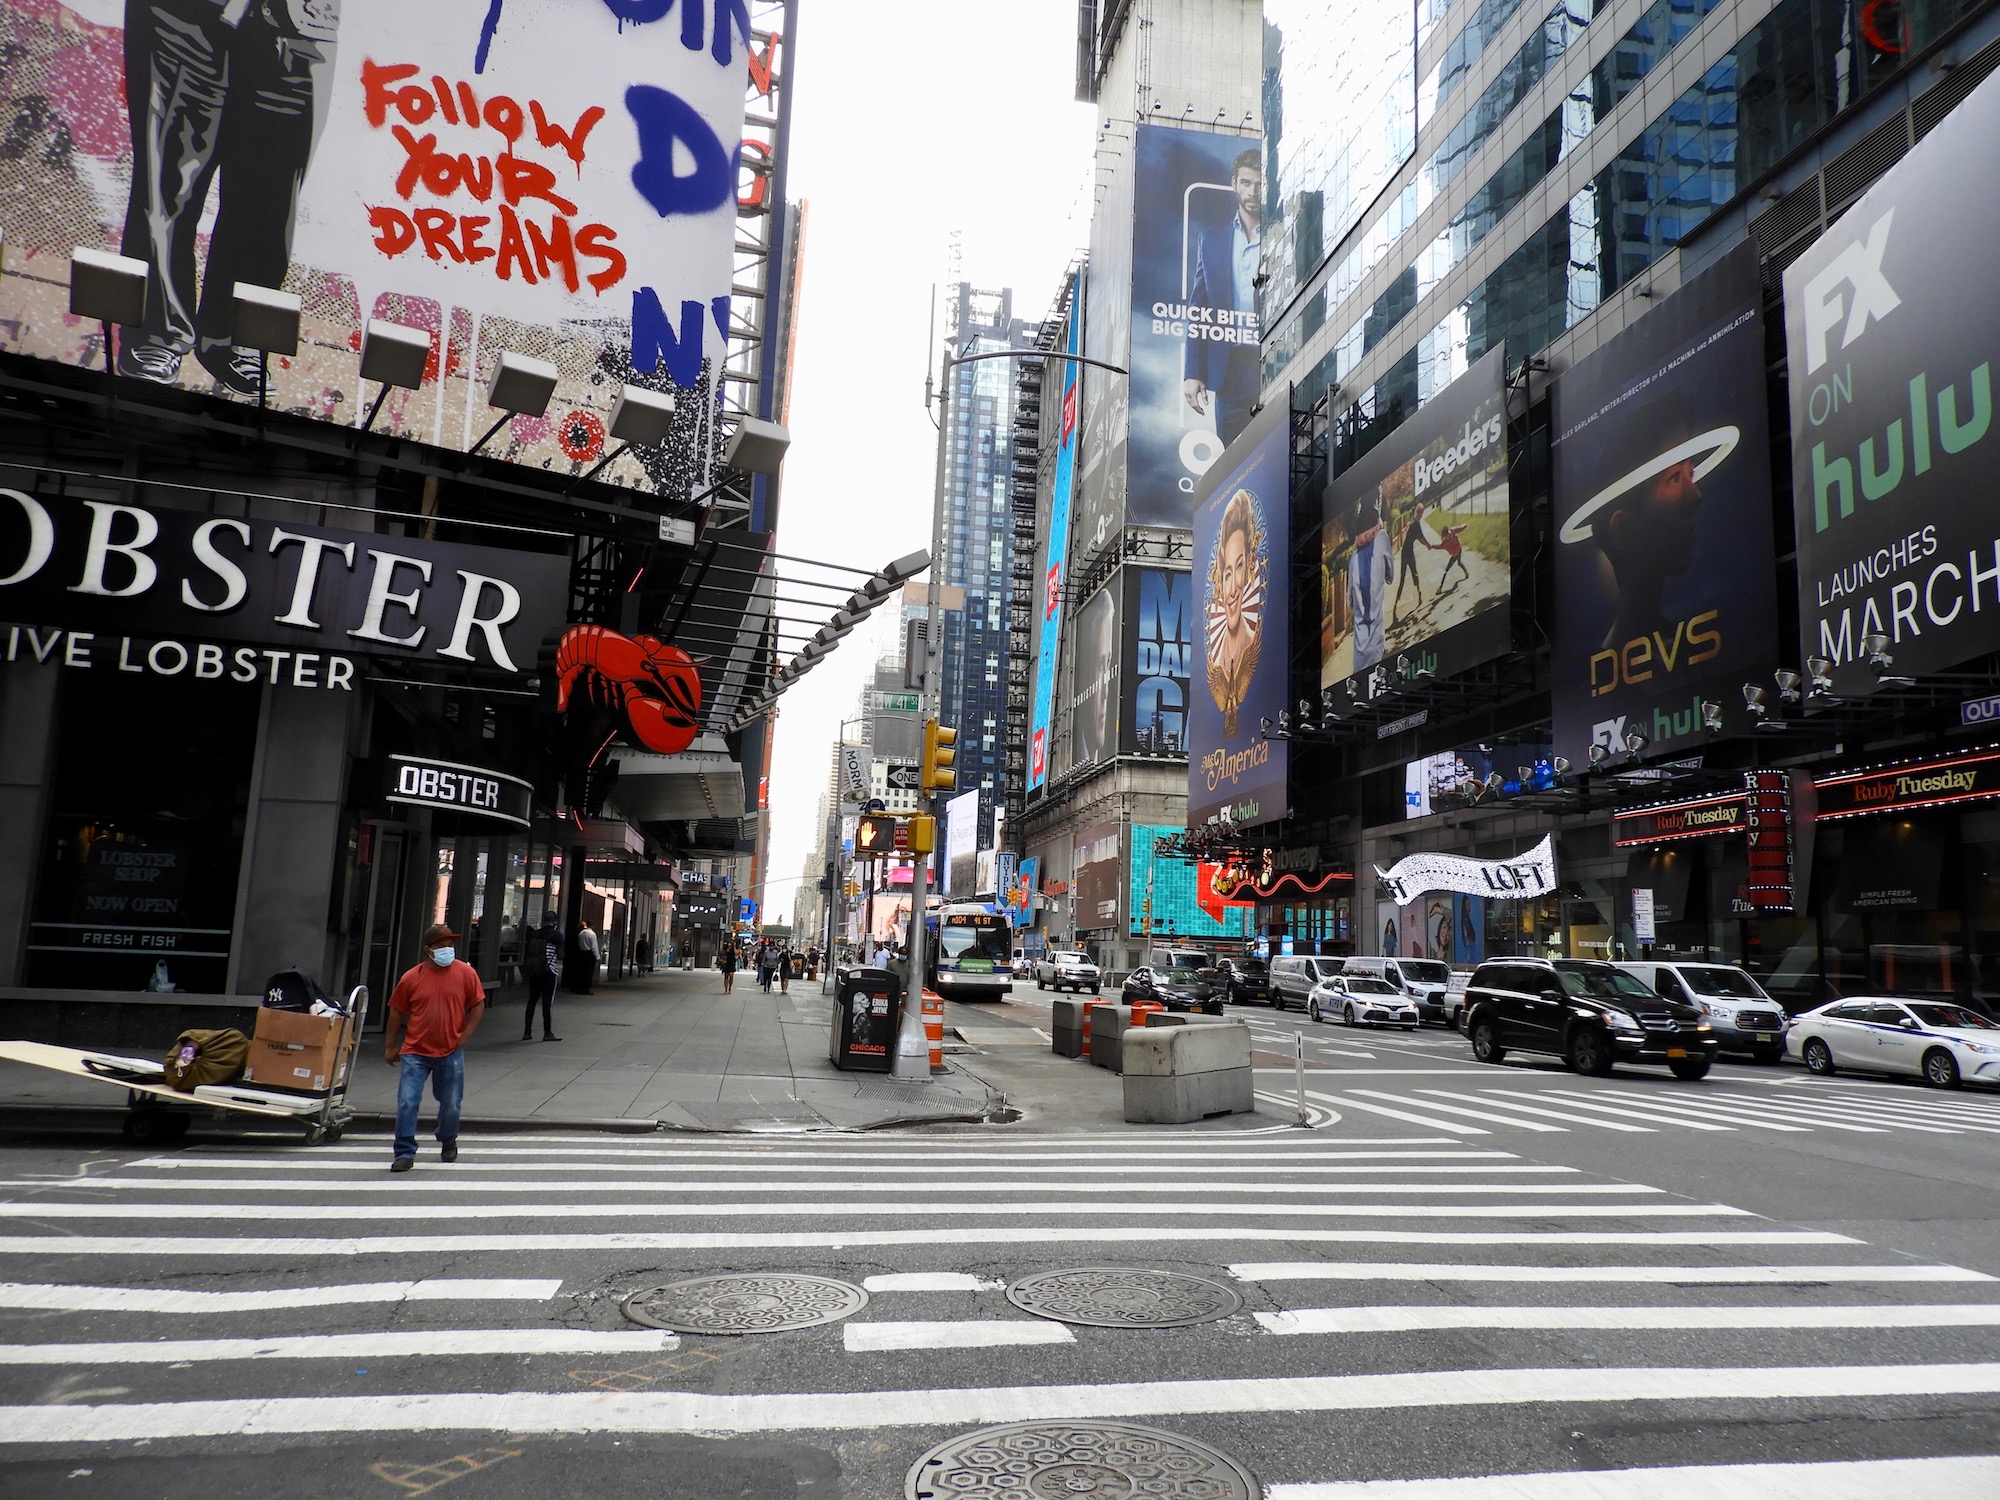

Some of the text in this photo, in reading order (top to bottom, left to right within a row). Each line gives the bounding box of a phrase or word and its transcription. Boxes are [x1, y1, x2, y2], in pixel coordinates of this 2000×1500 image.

[391, 123, 578, 217] YOUR
[364, 203, 627, 295] DREAMS
[1804, 206, 1902, 376] FX
[1152, 302, 1214, 322] QUICK
[1152, 320, 1183, 337] BIG
[1668, 348, 1695, 371] MACHINA
[1708, 308, 1755, 345] ANNIHILATION
[1809, 363, 1853, 427] ON
[1414, 412, 1502, 497] Breeders
[1811, 361, 1991, 534] hulu
[1818, 524, 1938, 608] LAUNCHES
[1820, 538, 2000, 668] MARCH
[118, 636, 356, 692] LOBSTER
[884, 694, 893, 708] W
[897, 695, 907, 709] 41
[1592, 715, 1628, 755] FX
[1653, 696, 1722, 742] hul
[896, 773, 918, 783] ONE
[1207, 737, 1269, 791] America
[395, 764, 500, 809] OBSTER
[1896, 770, 1977, 795] Tuesday
[1238, 798, 1259, 822] hulu
[1684, 806, 1739, 826] Tuesday
[100, 851, 176, 867] LOBSTER
[115, 867, 160, 882] SHOP
[1481, 863, 1544, 891] LOFT
[85, 896, 178, 913] NOW OPEN
[982, 917, 991, 925] ST
[82, 932, 177, 947] FRESH FISH
[850, 1043, 886, 1052] CHICAGO
